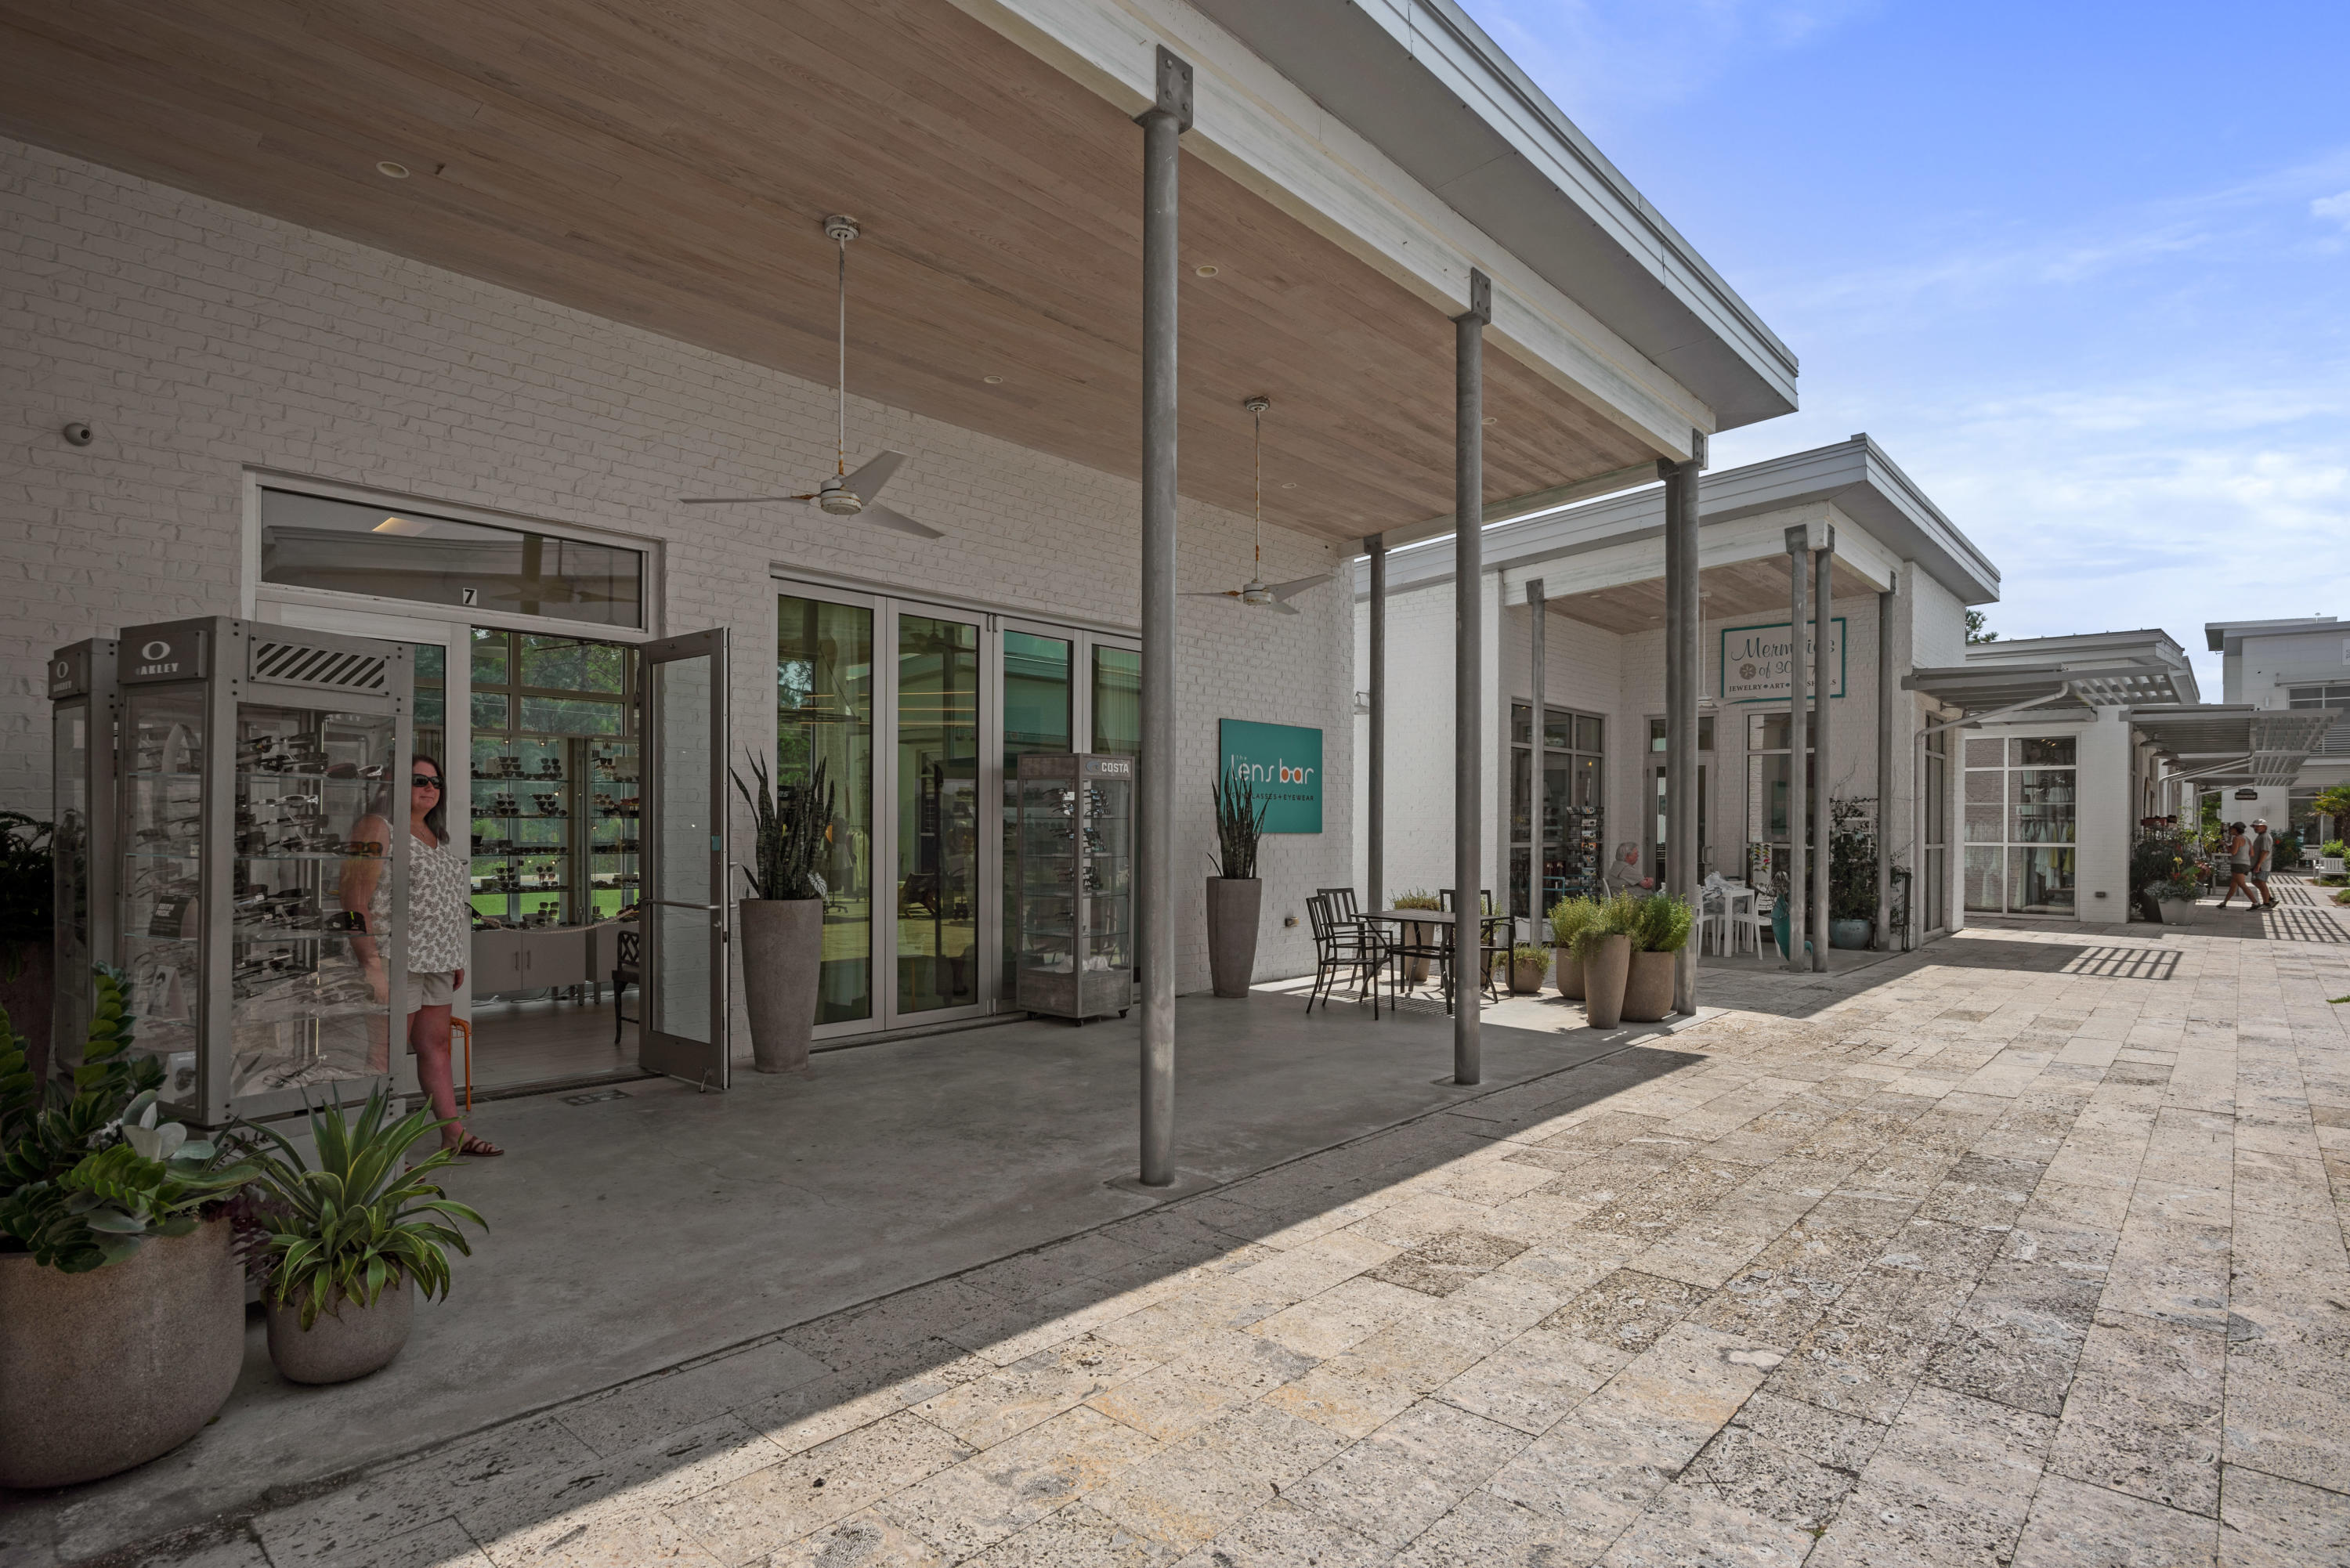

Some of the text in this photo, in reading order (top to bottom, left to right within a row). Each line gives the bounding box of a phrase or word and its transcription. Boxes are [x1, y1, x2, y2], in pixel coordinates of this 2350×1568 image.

[464, 588, 475, 605] 7
[1731, 638, 1835, 661] Mermis
[1759, 661, 1770, 678] of
[1729, 684, 1762, 692] JEWELRY
[1101, 762, 1129, 774] COSTA
[1231, 754, 1314, 785] lens bar
